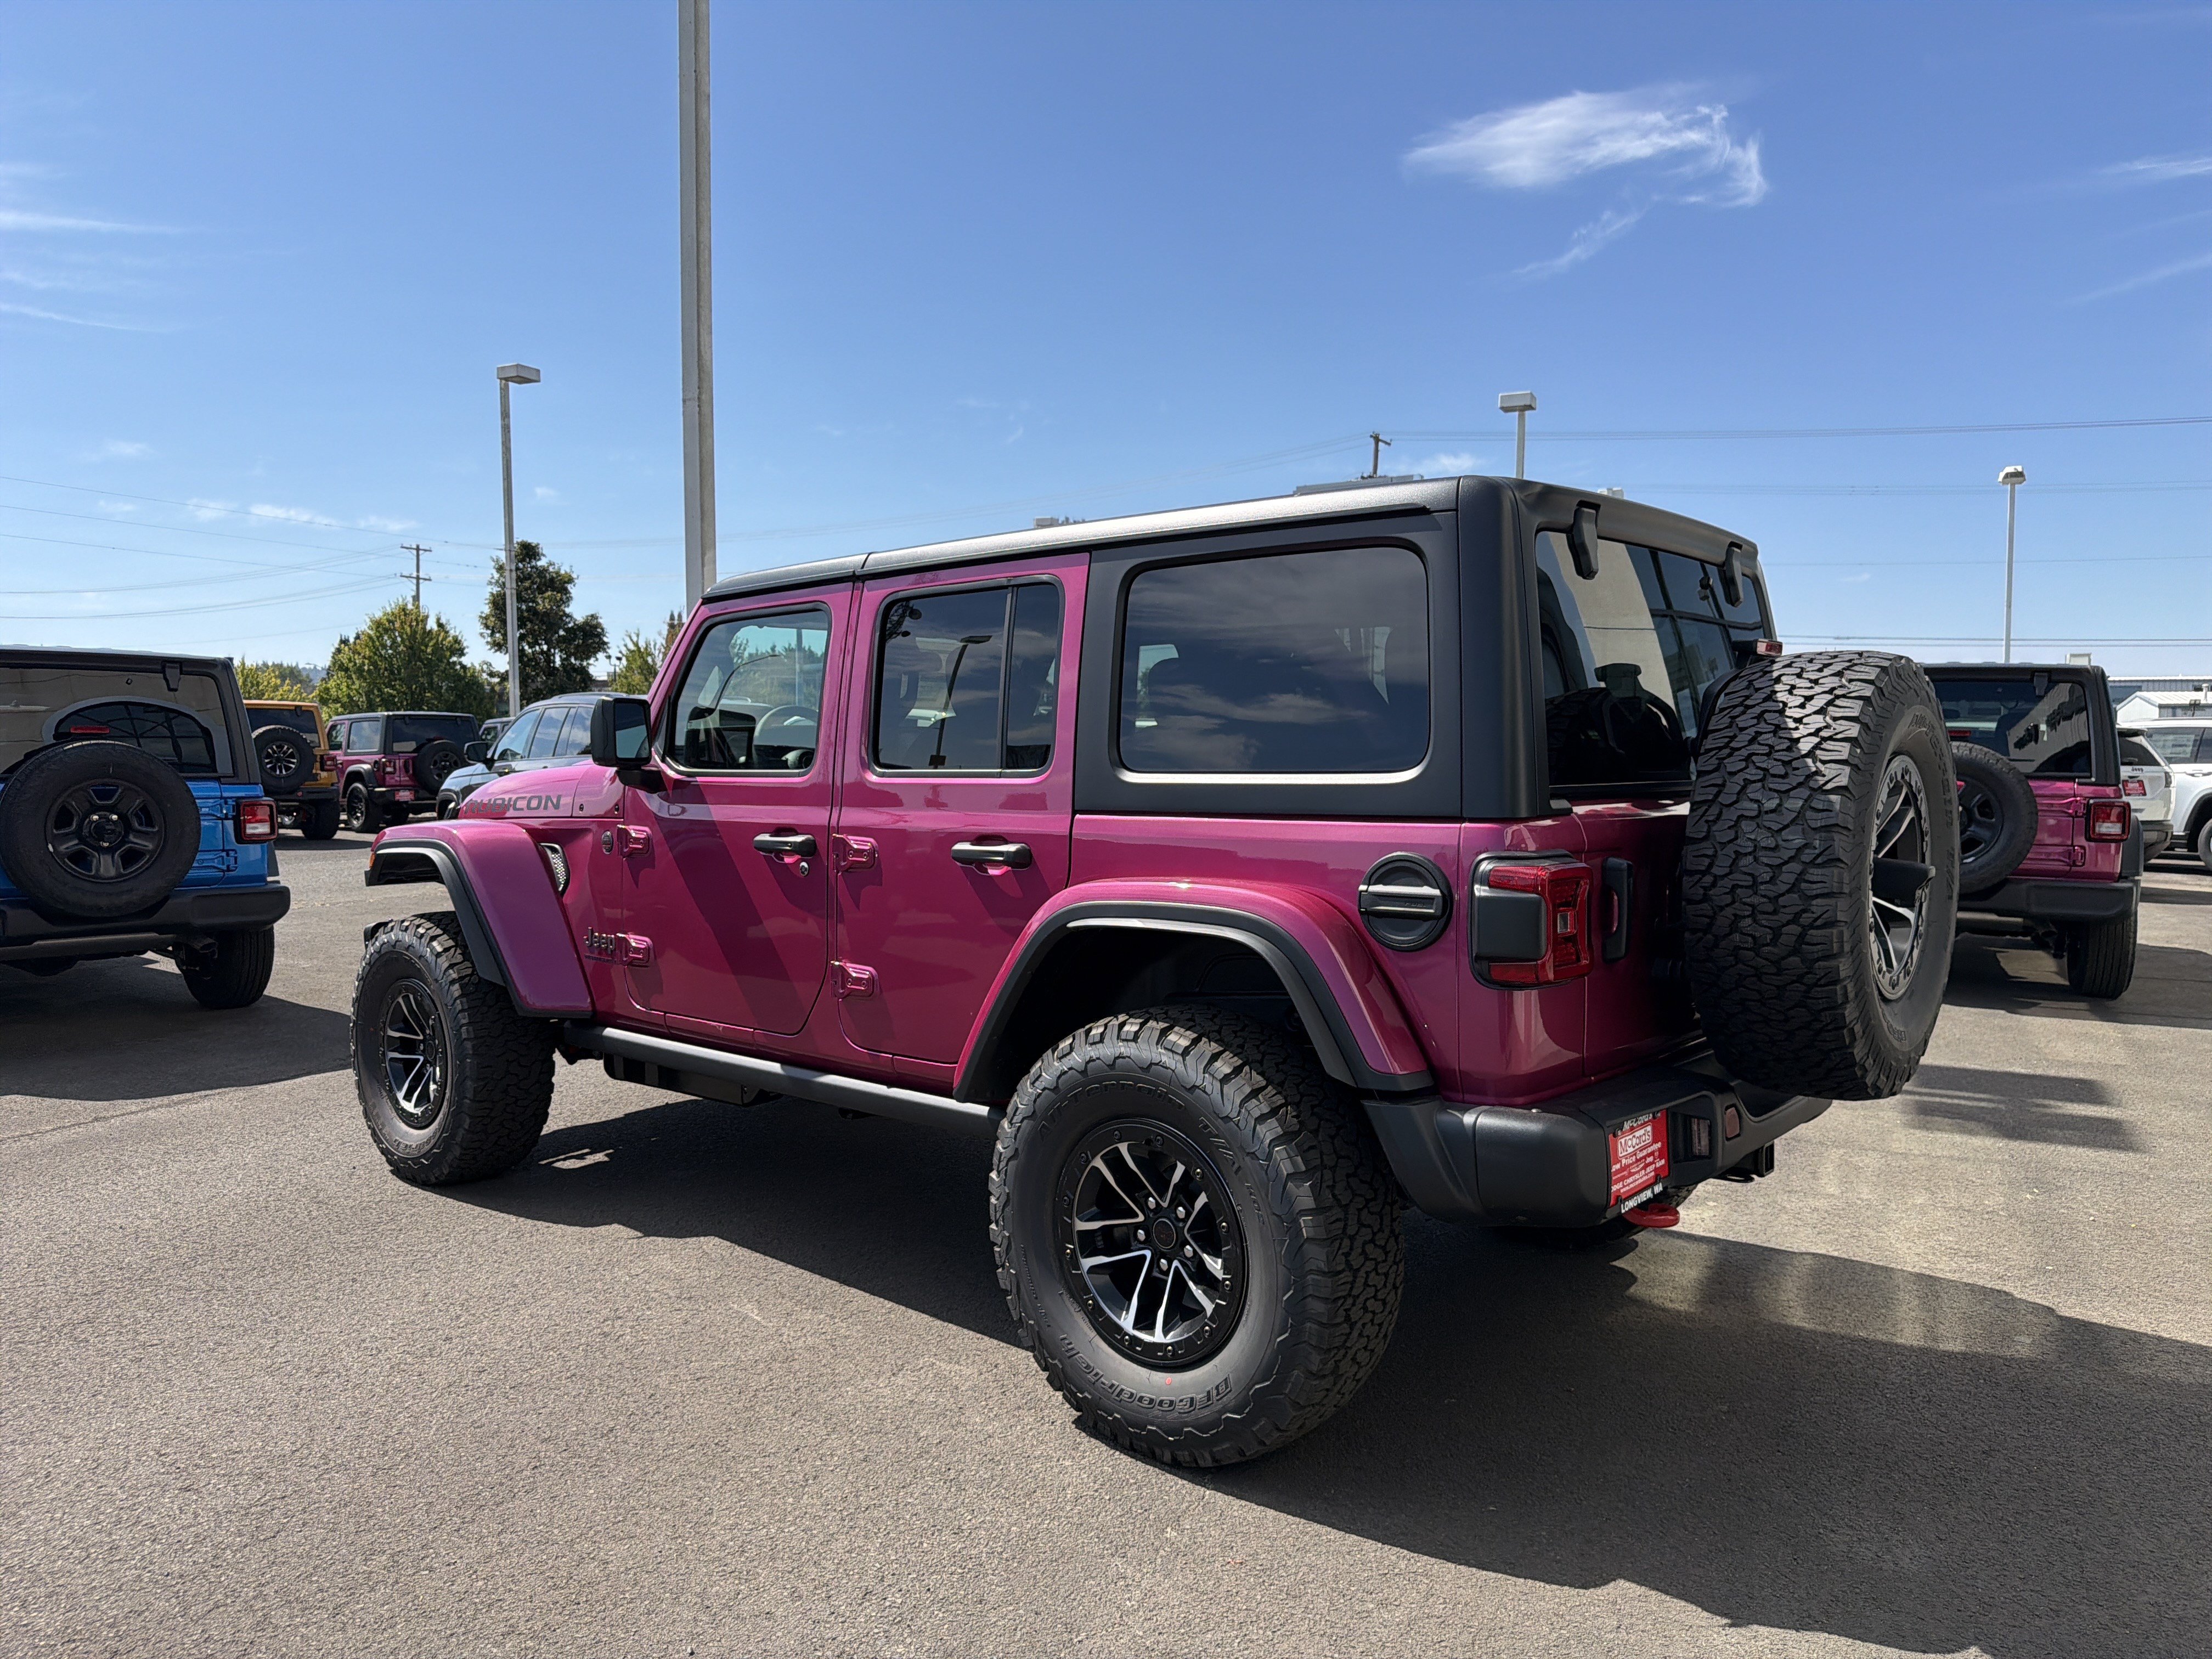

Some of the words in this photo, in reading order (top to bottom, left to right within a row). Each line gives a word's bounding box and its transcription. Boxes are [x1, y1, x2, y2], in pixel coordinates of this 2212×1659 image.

[464, 794, 562, 815] RUBICON
[583, 927, 615, 955] Jeep
[1037, 1080, 1187, 1142] All-Terrain
[1620, 1128, 1651, 1155] McCord's
[1622, 1155, 1636, 1167] Price
[1636, 1142, 1662, 1159] Guarantee
[1623, 1170, 1645, 1186] CHRYSLER
[1645, 1164, 1656, 1174] JEEP
[1621, 1188, 1654, 1214] LONGVIEW,
[1654, 1182, 1663, 1195] WA
[1059, 1333, 1232, 1414] BFGoodrich
